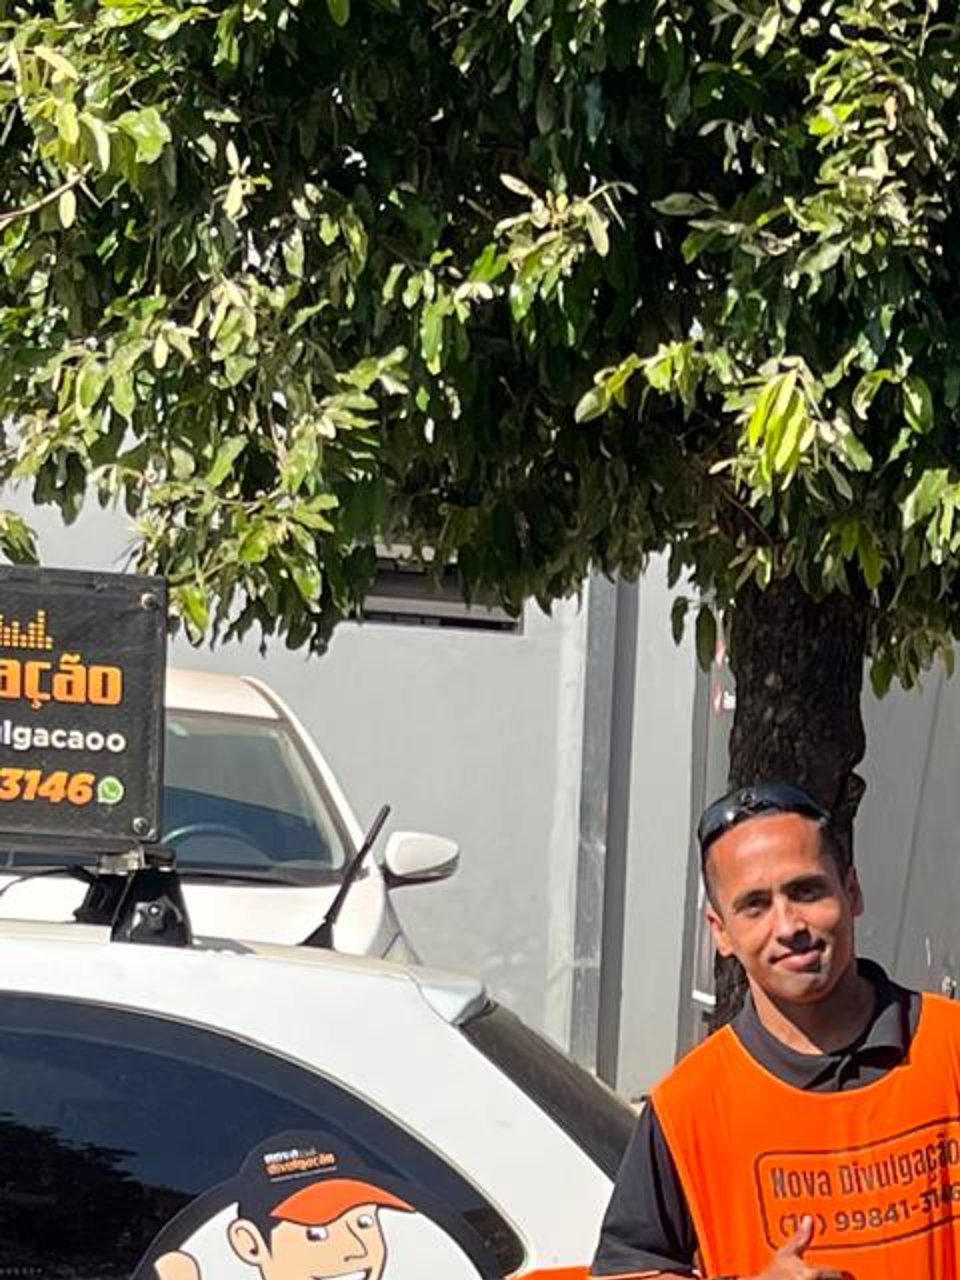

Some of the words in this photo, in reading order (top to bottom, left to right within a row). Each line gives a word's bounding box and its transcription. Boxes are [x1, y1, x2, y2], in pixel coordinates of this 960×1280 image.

[0, 719, 127, 753] lgacaoo
[770, 1167, 832, 1199] Nova
[839, 1132, 960, 1196] Divulgação
[779, 1212, 827, 1238] (1)
